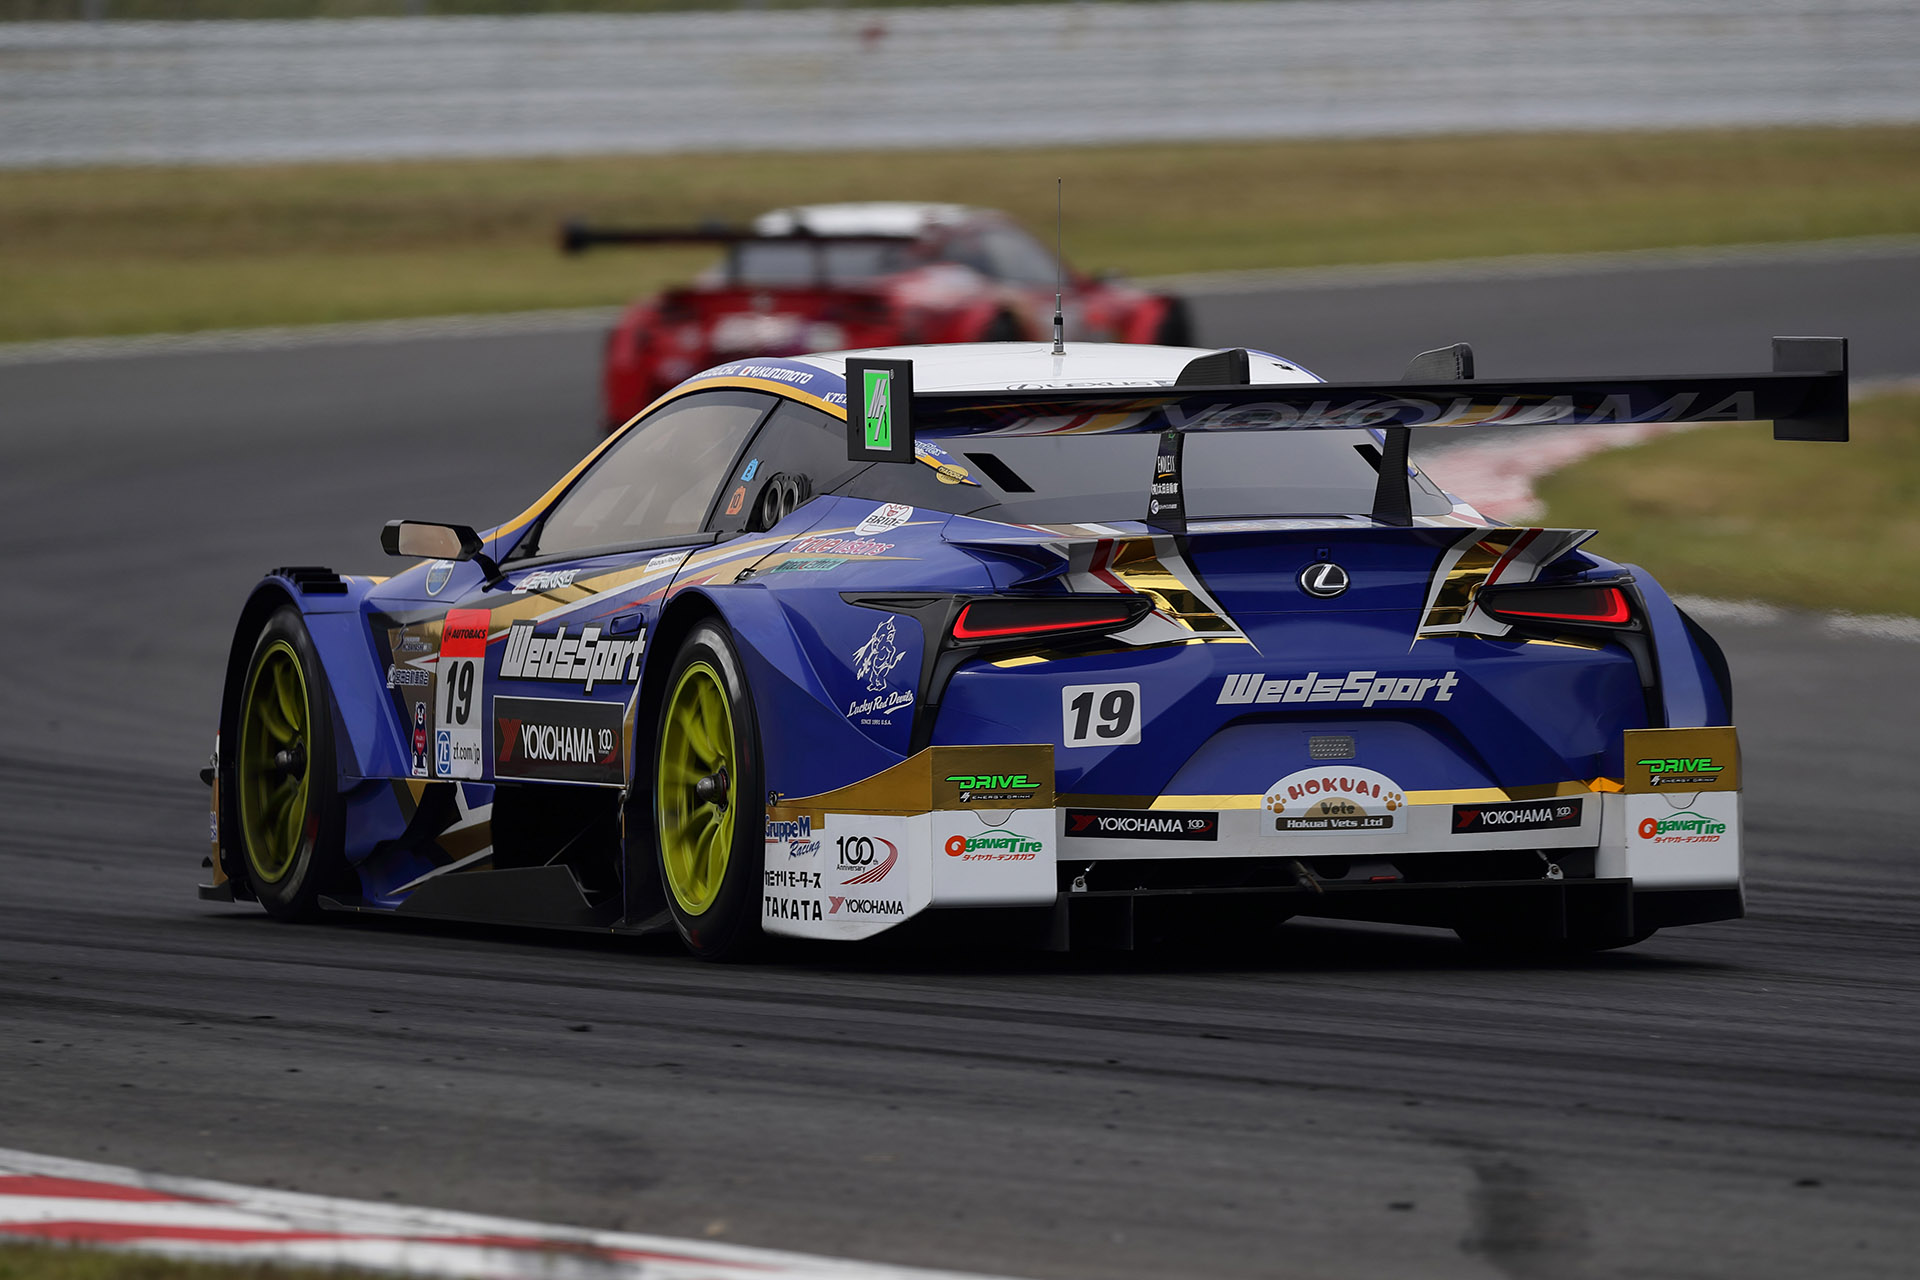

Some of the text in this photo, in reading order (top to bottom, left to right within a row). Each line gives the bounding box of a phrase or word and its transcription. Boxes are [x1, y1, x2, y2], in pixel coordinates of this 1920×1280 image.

[1162, 391, 1756, 431] YOKOHAMA
[865, 515, 905, 526] BRIDE
[452, 629, 486, 639] AUTOBACS
[500, 625, 646, 692] WedsSport
[446, 660, 475, 725] 19
[1216, 671, 1459, 707] WedsSport
[846, 699, 873, 718] Lucky
[873, 695, 889, 710] Red
[1070, 689, 1135, 740] 19
[521, 724, 596, 763] YOKOHAMA
[1637, 758, 1724, 773] DRIVE
[946, 775, 1041, 789] DRIVE
[1288, 777, 1380, 800] HOKUAI
[1320, 801, 1355, 815] Vets
[1481, 808, 1553, 825] YOKOHAMA
[1098, 817, 1183, 833] YOKOHAMA
[1287, 820, 1328, 829] Hokuai
[1331, 819, 1357, 828] Vets
[788, 841, 821, 861] Racing
[962, 854, 1036, 862] タイヤガーデンオガワ
[836, 864, 866, 873] Anniversary
[765, 896, 822, 920] TAKATA
[845, 899, 904, 914] YOKOHAMA
